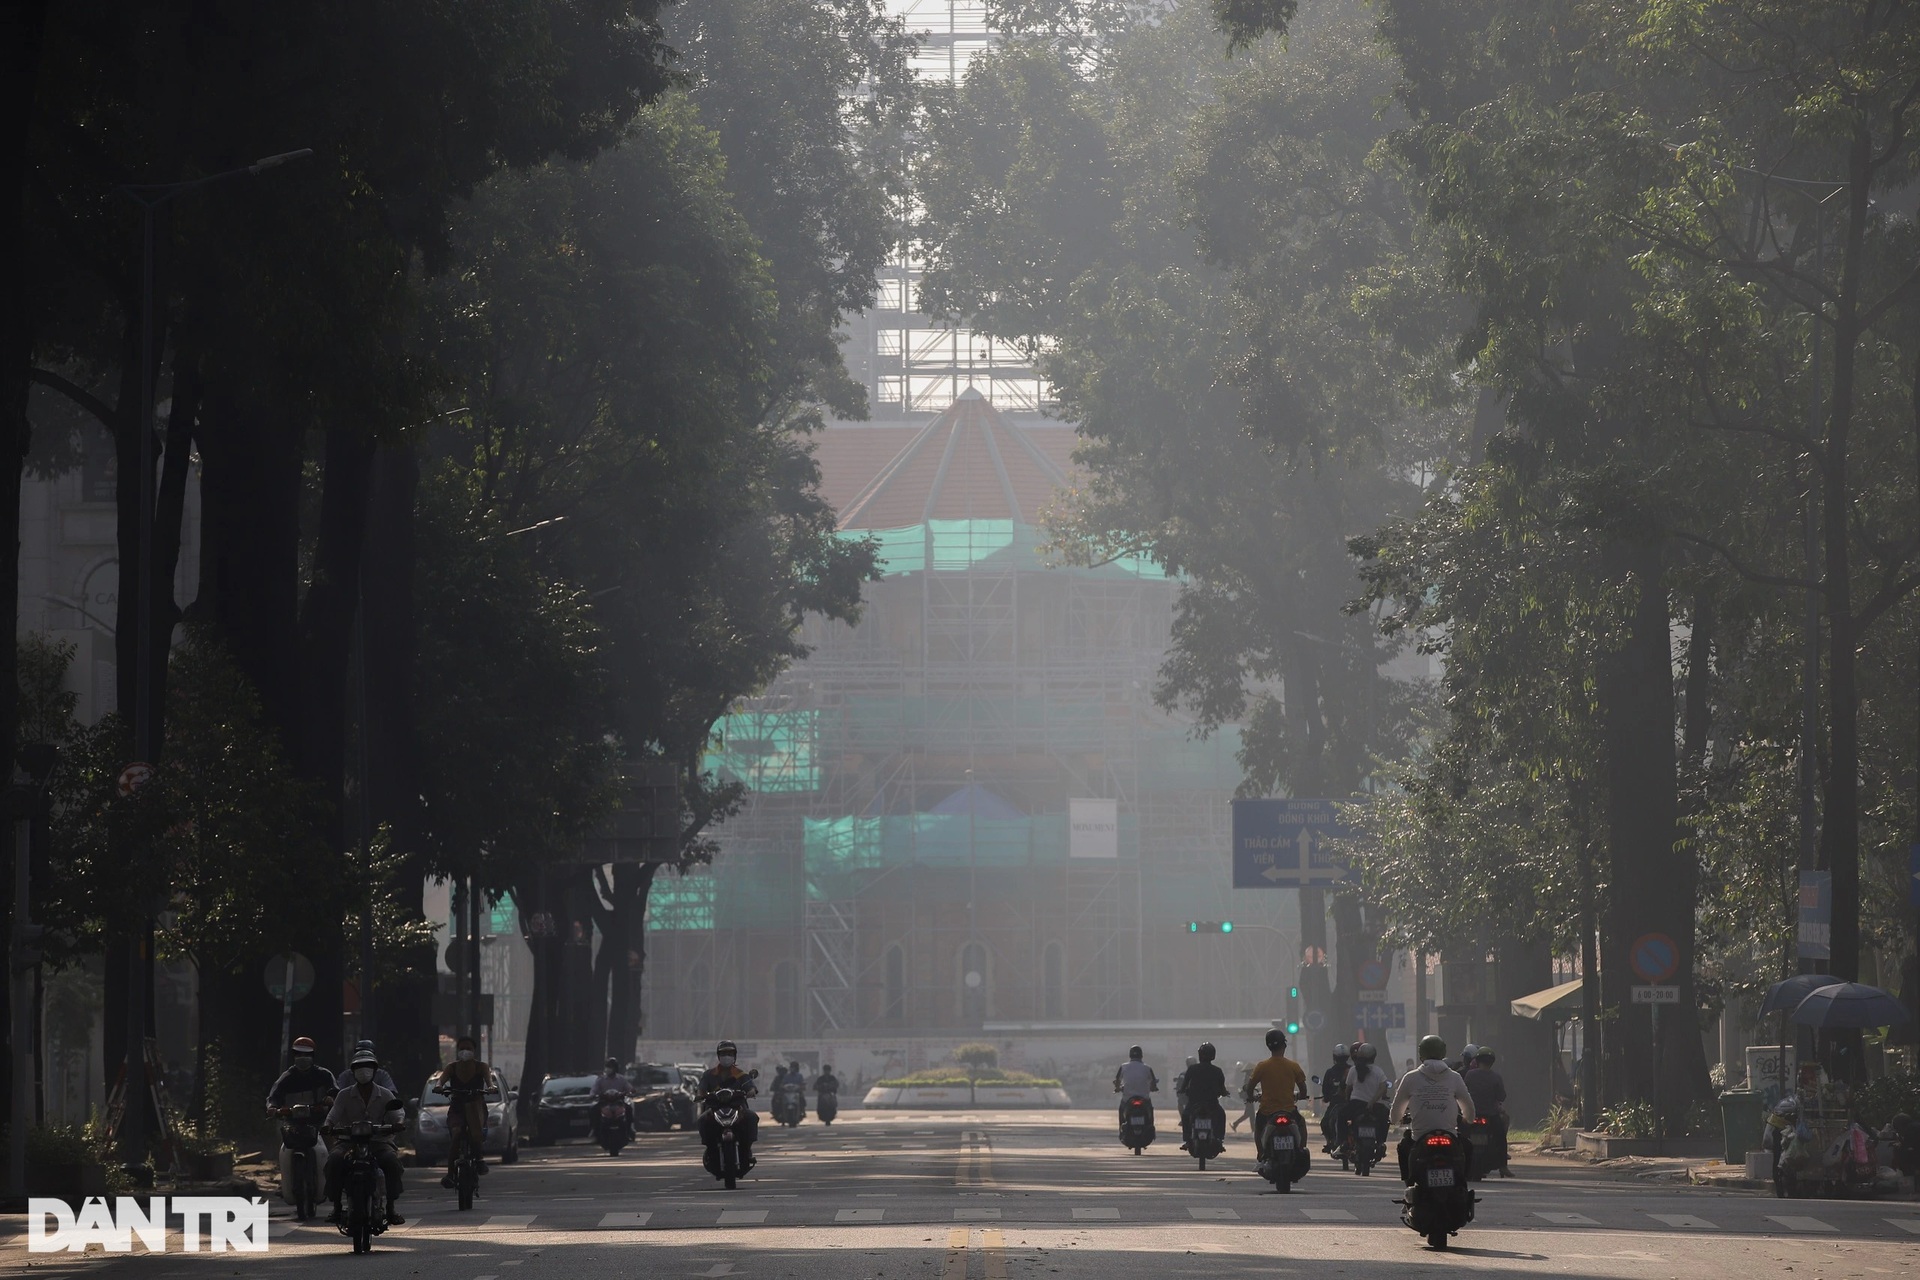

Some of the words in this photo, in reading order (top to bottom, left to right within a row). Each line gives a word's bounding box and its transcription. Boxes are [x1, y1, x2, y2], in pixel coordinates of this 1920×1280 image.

[1278, 810, 1304, 825] ĐỒNG
[1307, 810, 1330, 825] KHỞI
[1072, 823, 1115, 833] MONUMENT
[1243, 835, 1268, 849] THẢO
[1252, 851, 1275, 865] VIÊN
